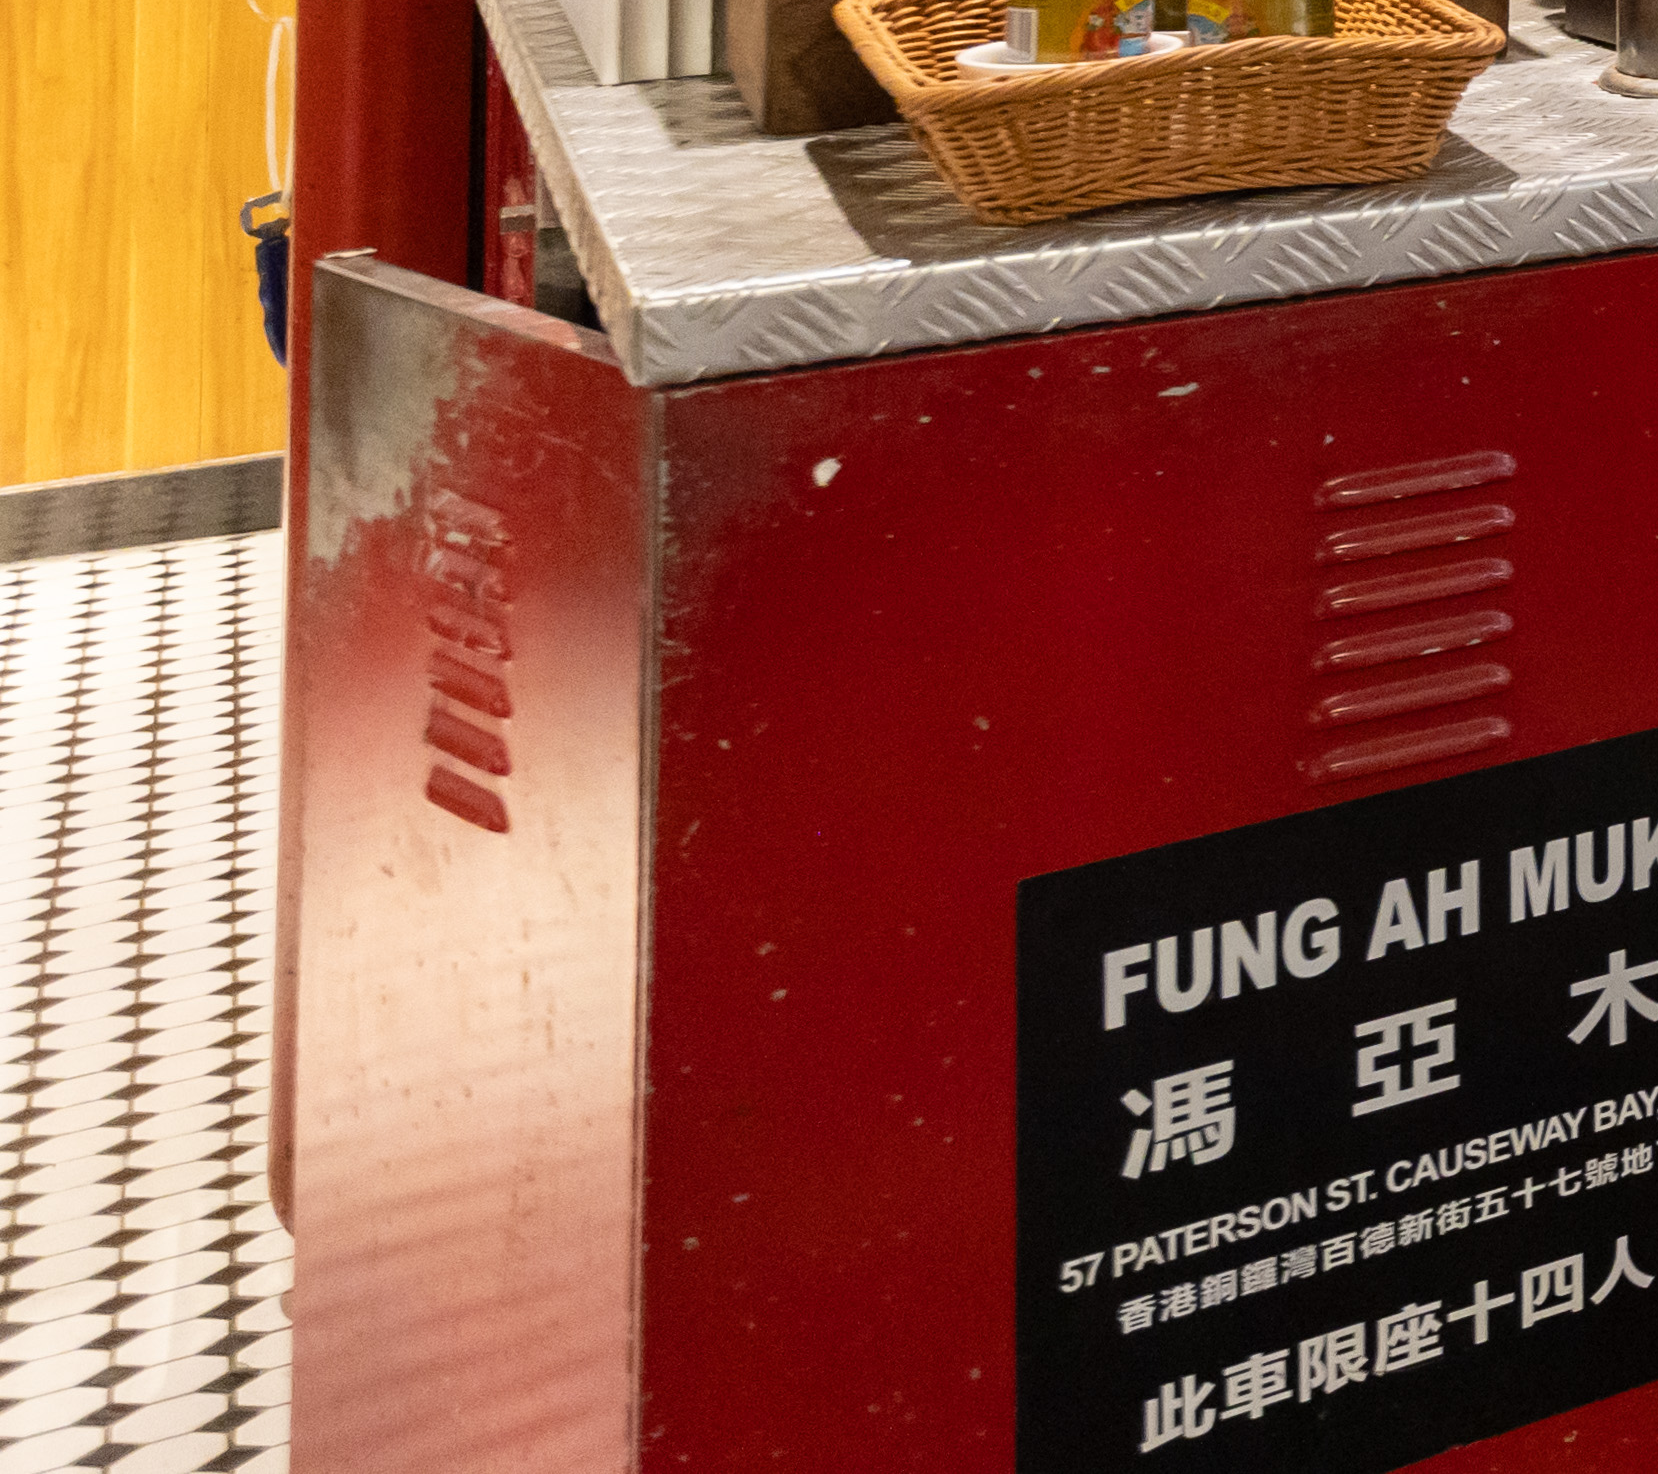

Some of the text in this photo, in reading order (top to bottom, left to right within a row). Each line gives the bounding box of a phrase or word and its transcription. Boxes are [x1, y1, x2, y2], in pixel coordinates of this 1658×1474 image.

[1101, 896, 1342, 1031] FUNG
[1366, 859, 1483, 961] AH
[1118, 1059, 1237, 1180] 馮
[1351, 998, 1462, 1118] 亞
[1058, 1251, 1106, 1295] 57
[1111, 1186, 1319, 1278] PATERSON
[1323, 1168, 1379, 1212] ST.
[1386, 1106, 1588, 1195] CAUSEWAY
[1137, 1233, 1656, 1454] 此車限座十四人
